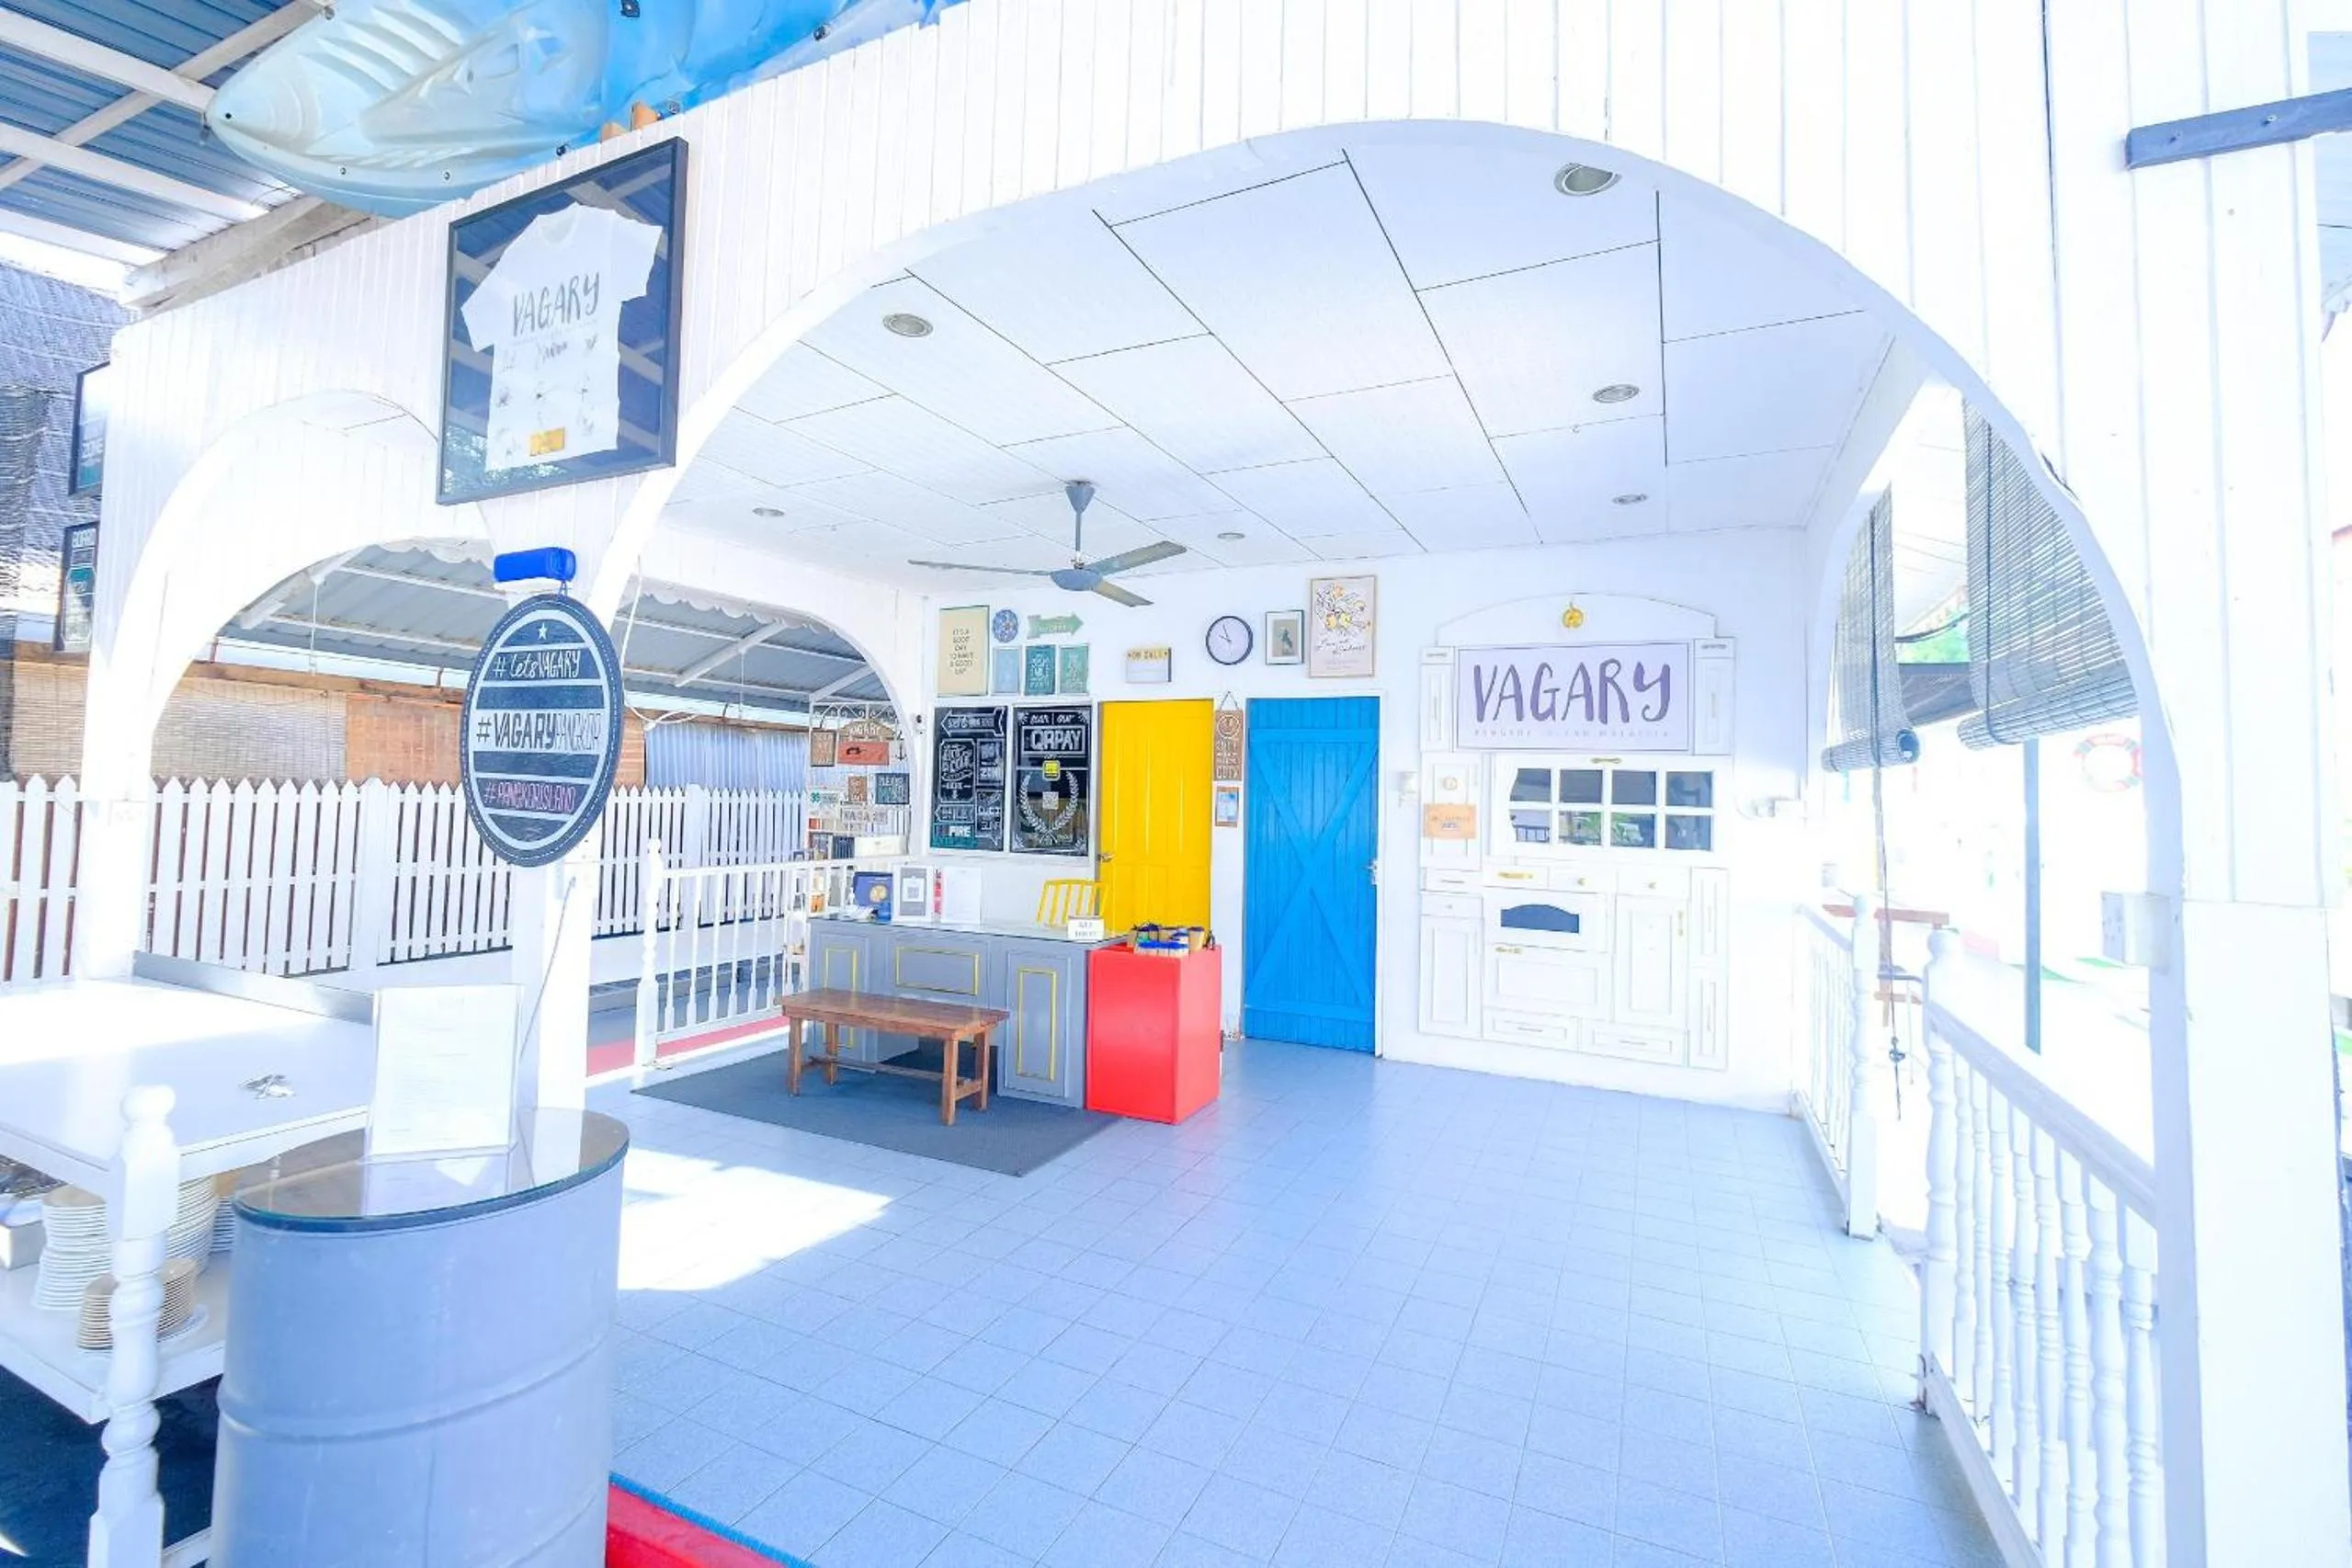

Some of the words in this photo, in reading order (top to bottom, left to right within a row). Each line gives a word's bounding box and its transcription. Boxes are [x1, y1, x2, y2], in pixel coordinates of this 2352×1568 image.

[513, 271, 600, 337] VAGARY
[1472, 657, 1672, 725] VAGARY
[1030, 729, 1082, 751] QRPAY
